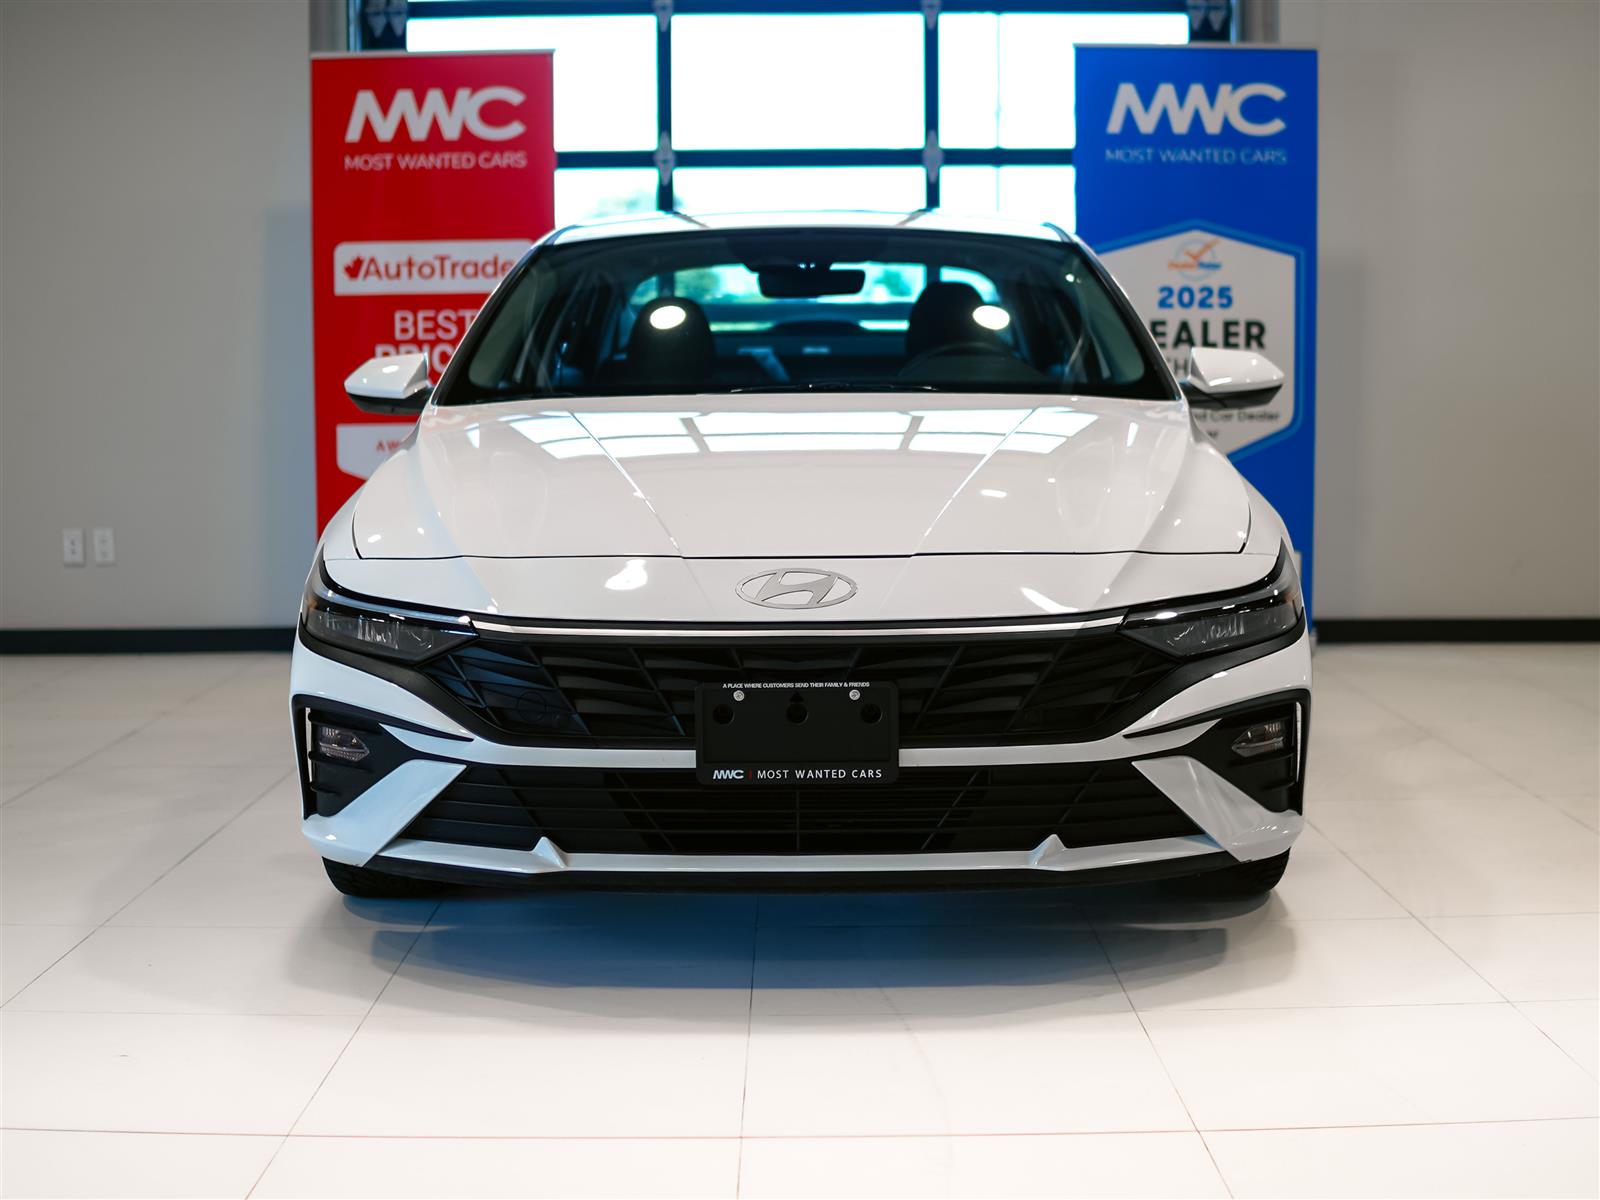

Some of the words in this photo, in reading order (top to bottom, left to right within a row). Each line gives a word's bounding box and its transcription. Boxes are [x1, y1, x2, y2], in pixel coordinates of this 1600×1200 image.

[344, 85, 527, 143] MWC
[1106, 82, 1287, 136] MWC
[344, 153, 394, 171] MOST
[396, 152, 477, 170] WANTED
[478, 151, 527, 169] CARS
[1104, 147, 1153, 164] MOST
[1159, 147, 1235, 164] WANTED
[1240, 147, 1287, 164] CARS
[363, 255, 515, 281] AutoTrade
[1157, 286, 1233, 309] 2025
[394, 309, 480, 341] BEST
[1149, 319, 1266, 349] EALER
[712, 769, 745, 780] MWC
[757, 769, 790, 779] MOST
[795, 769, 847, 779] WANTED
[851, 769, 883, 778] CARS
